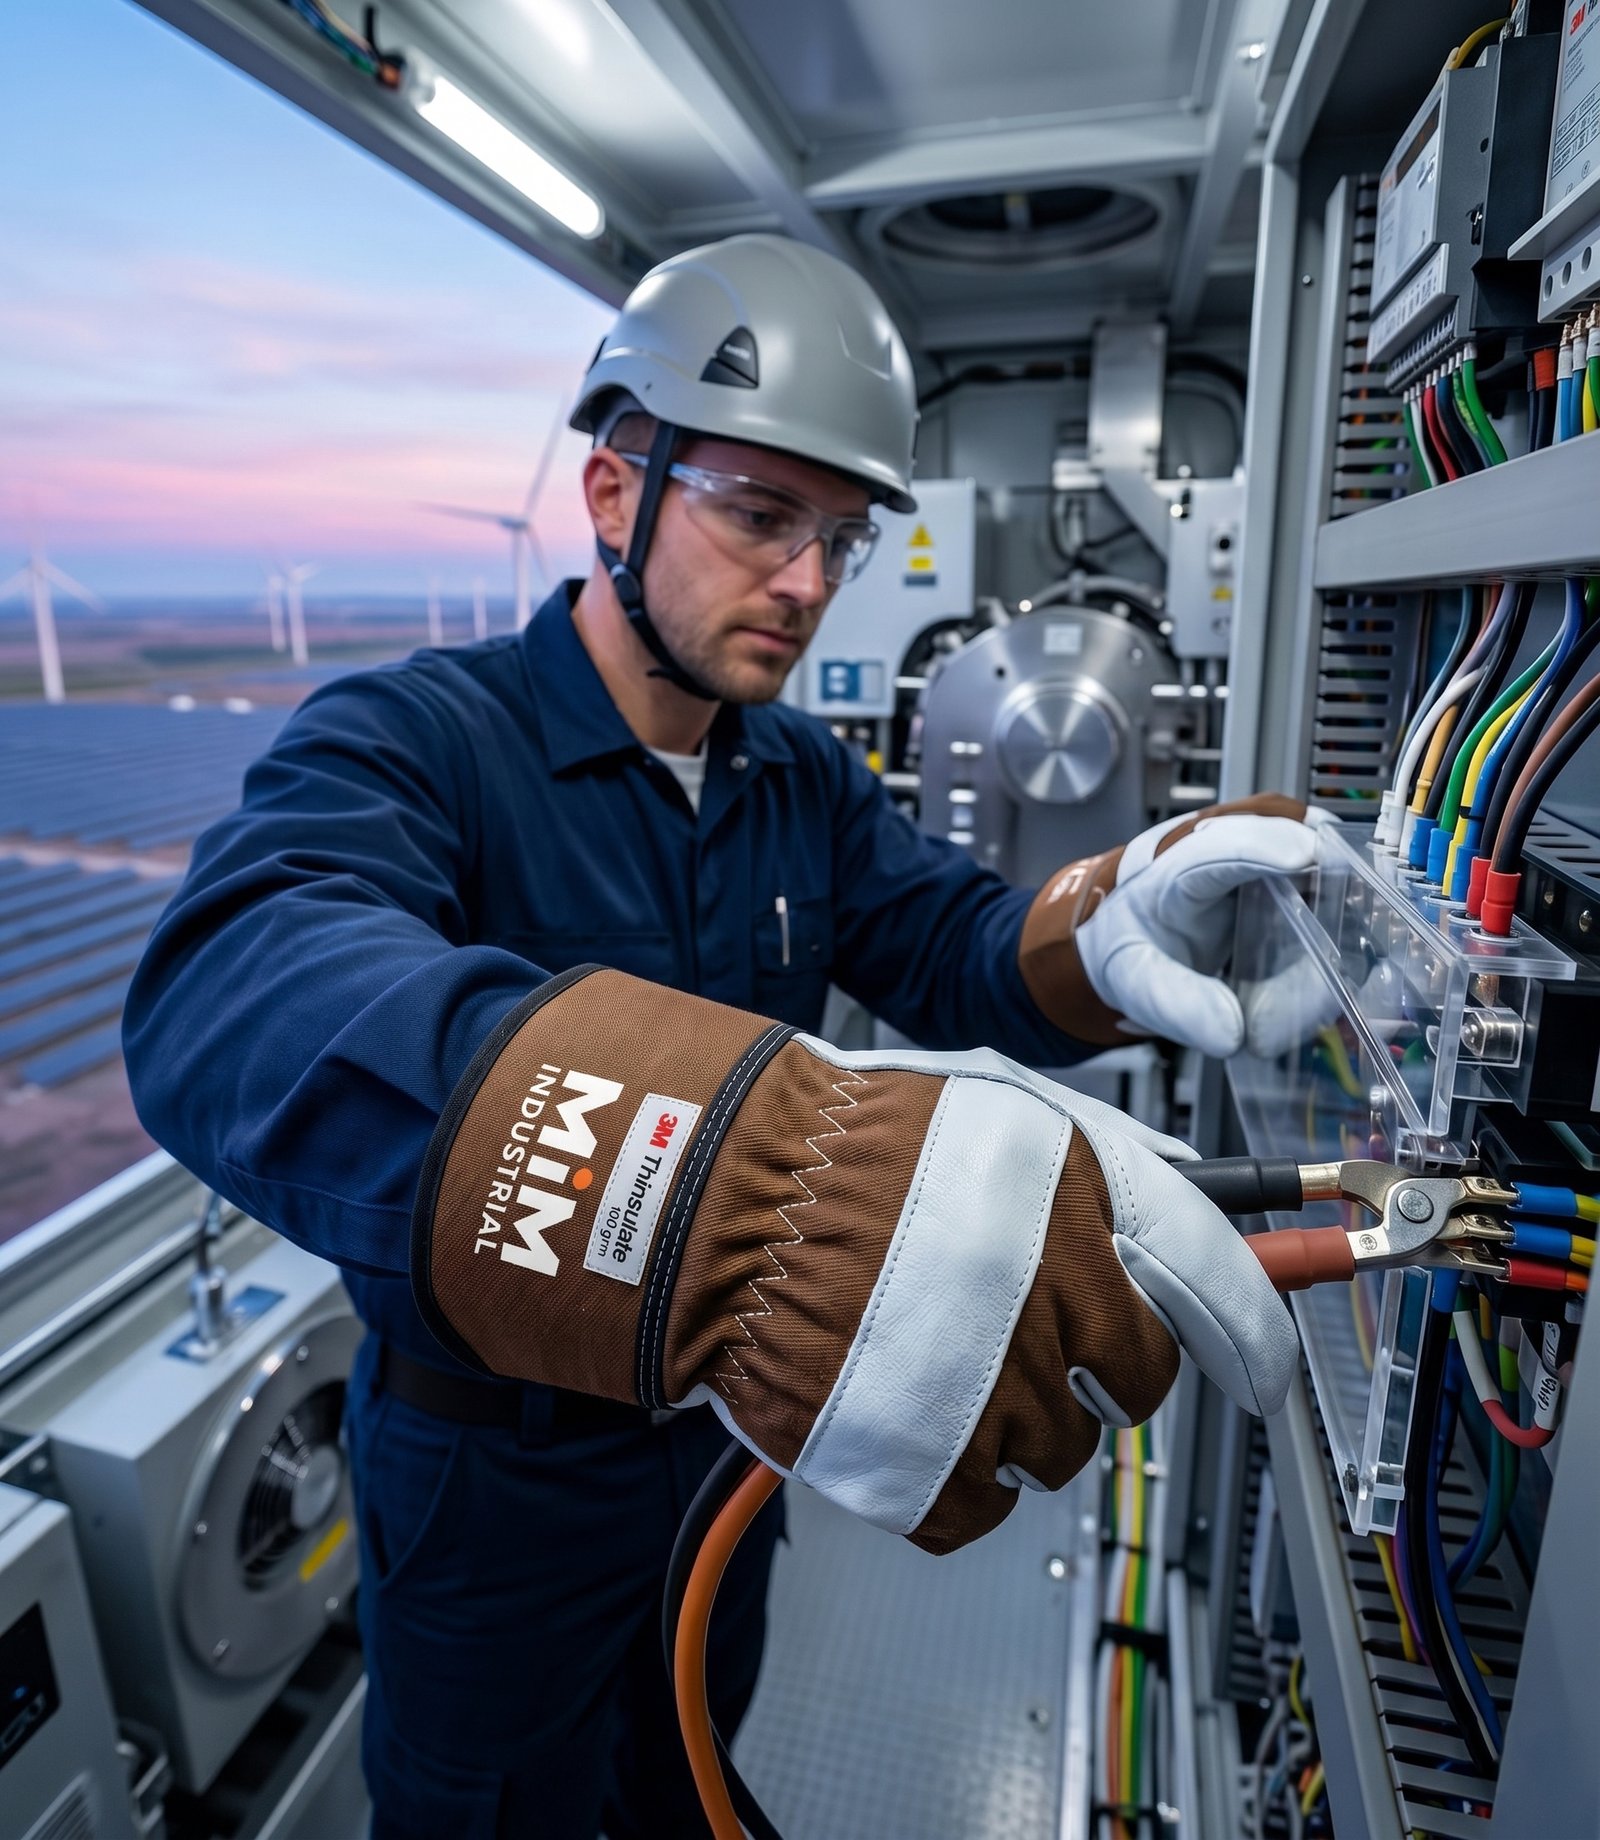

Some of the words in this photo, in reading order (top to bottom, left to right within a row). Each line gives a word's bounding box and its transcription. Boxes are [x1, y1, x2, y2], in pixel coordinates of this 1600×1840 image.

[650, 1112, 679, 1150] 3M
[474, 1063, 562, 1255] INDUSTRIAL
[605, 1206, 622, 1230] 100
[612, 1155, 663, 1263] Thinsulate
[597, 1228, 612, 1258] grm
